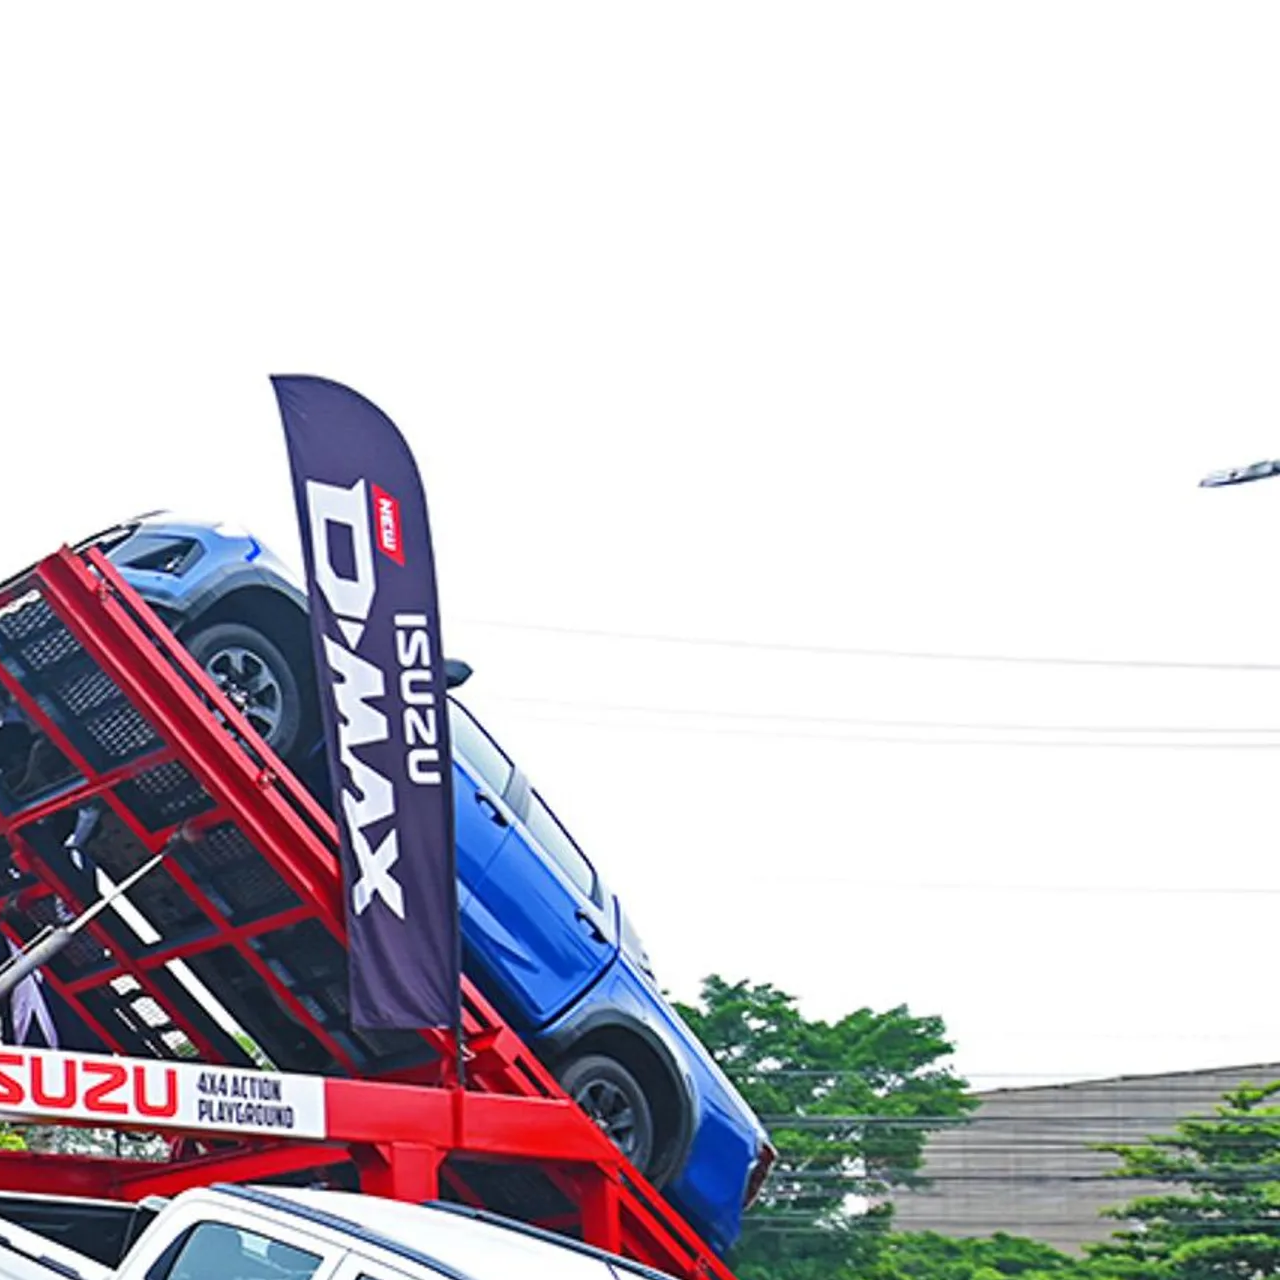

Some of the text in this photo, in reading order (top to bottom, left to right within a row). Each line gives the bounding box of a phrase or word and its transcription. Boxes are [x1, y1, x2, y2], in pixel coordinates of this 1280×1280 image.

[377, 498, 398, 551] NEW
[393, 613, 441, 784] ISUZU
[196, 1073, 282, 1101] 4X4 ACTION
[197, 1099, 294, 1129] PLAYGROUND
